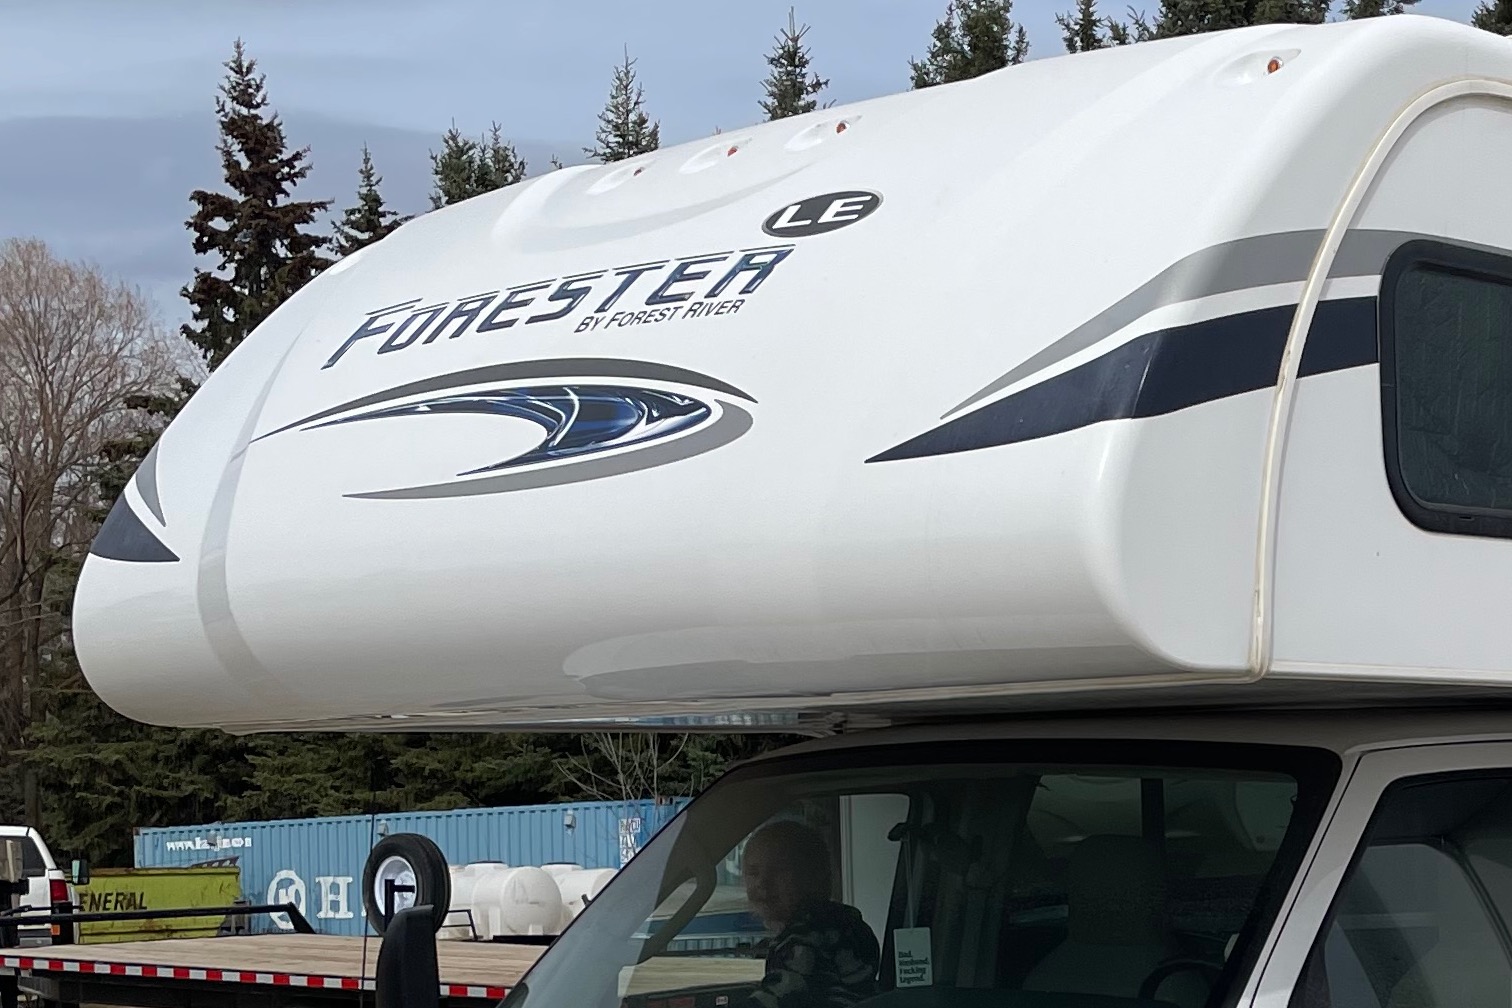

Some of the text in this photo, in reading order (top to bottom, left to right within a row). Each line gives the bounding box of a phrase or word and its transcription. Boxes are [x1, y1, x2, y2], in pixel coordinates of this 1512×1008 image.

[772, 195, 873, 230] LE
[321, 244, 796, 370] FORESTER
[574, 298, 745, 333] BY FOREST RIVER
[79, 891, 148, 913] ENERAL
